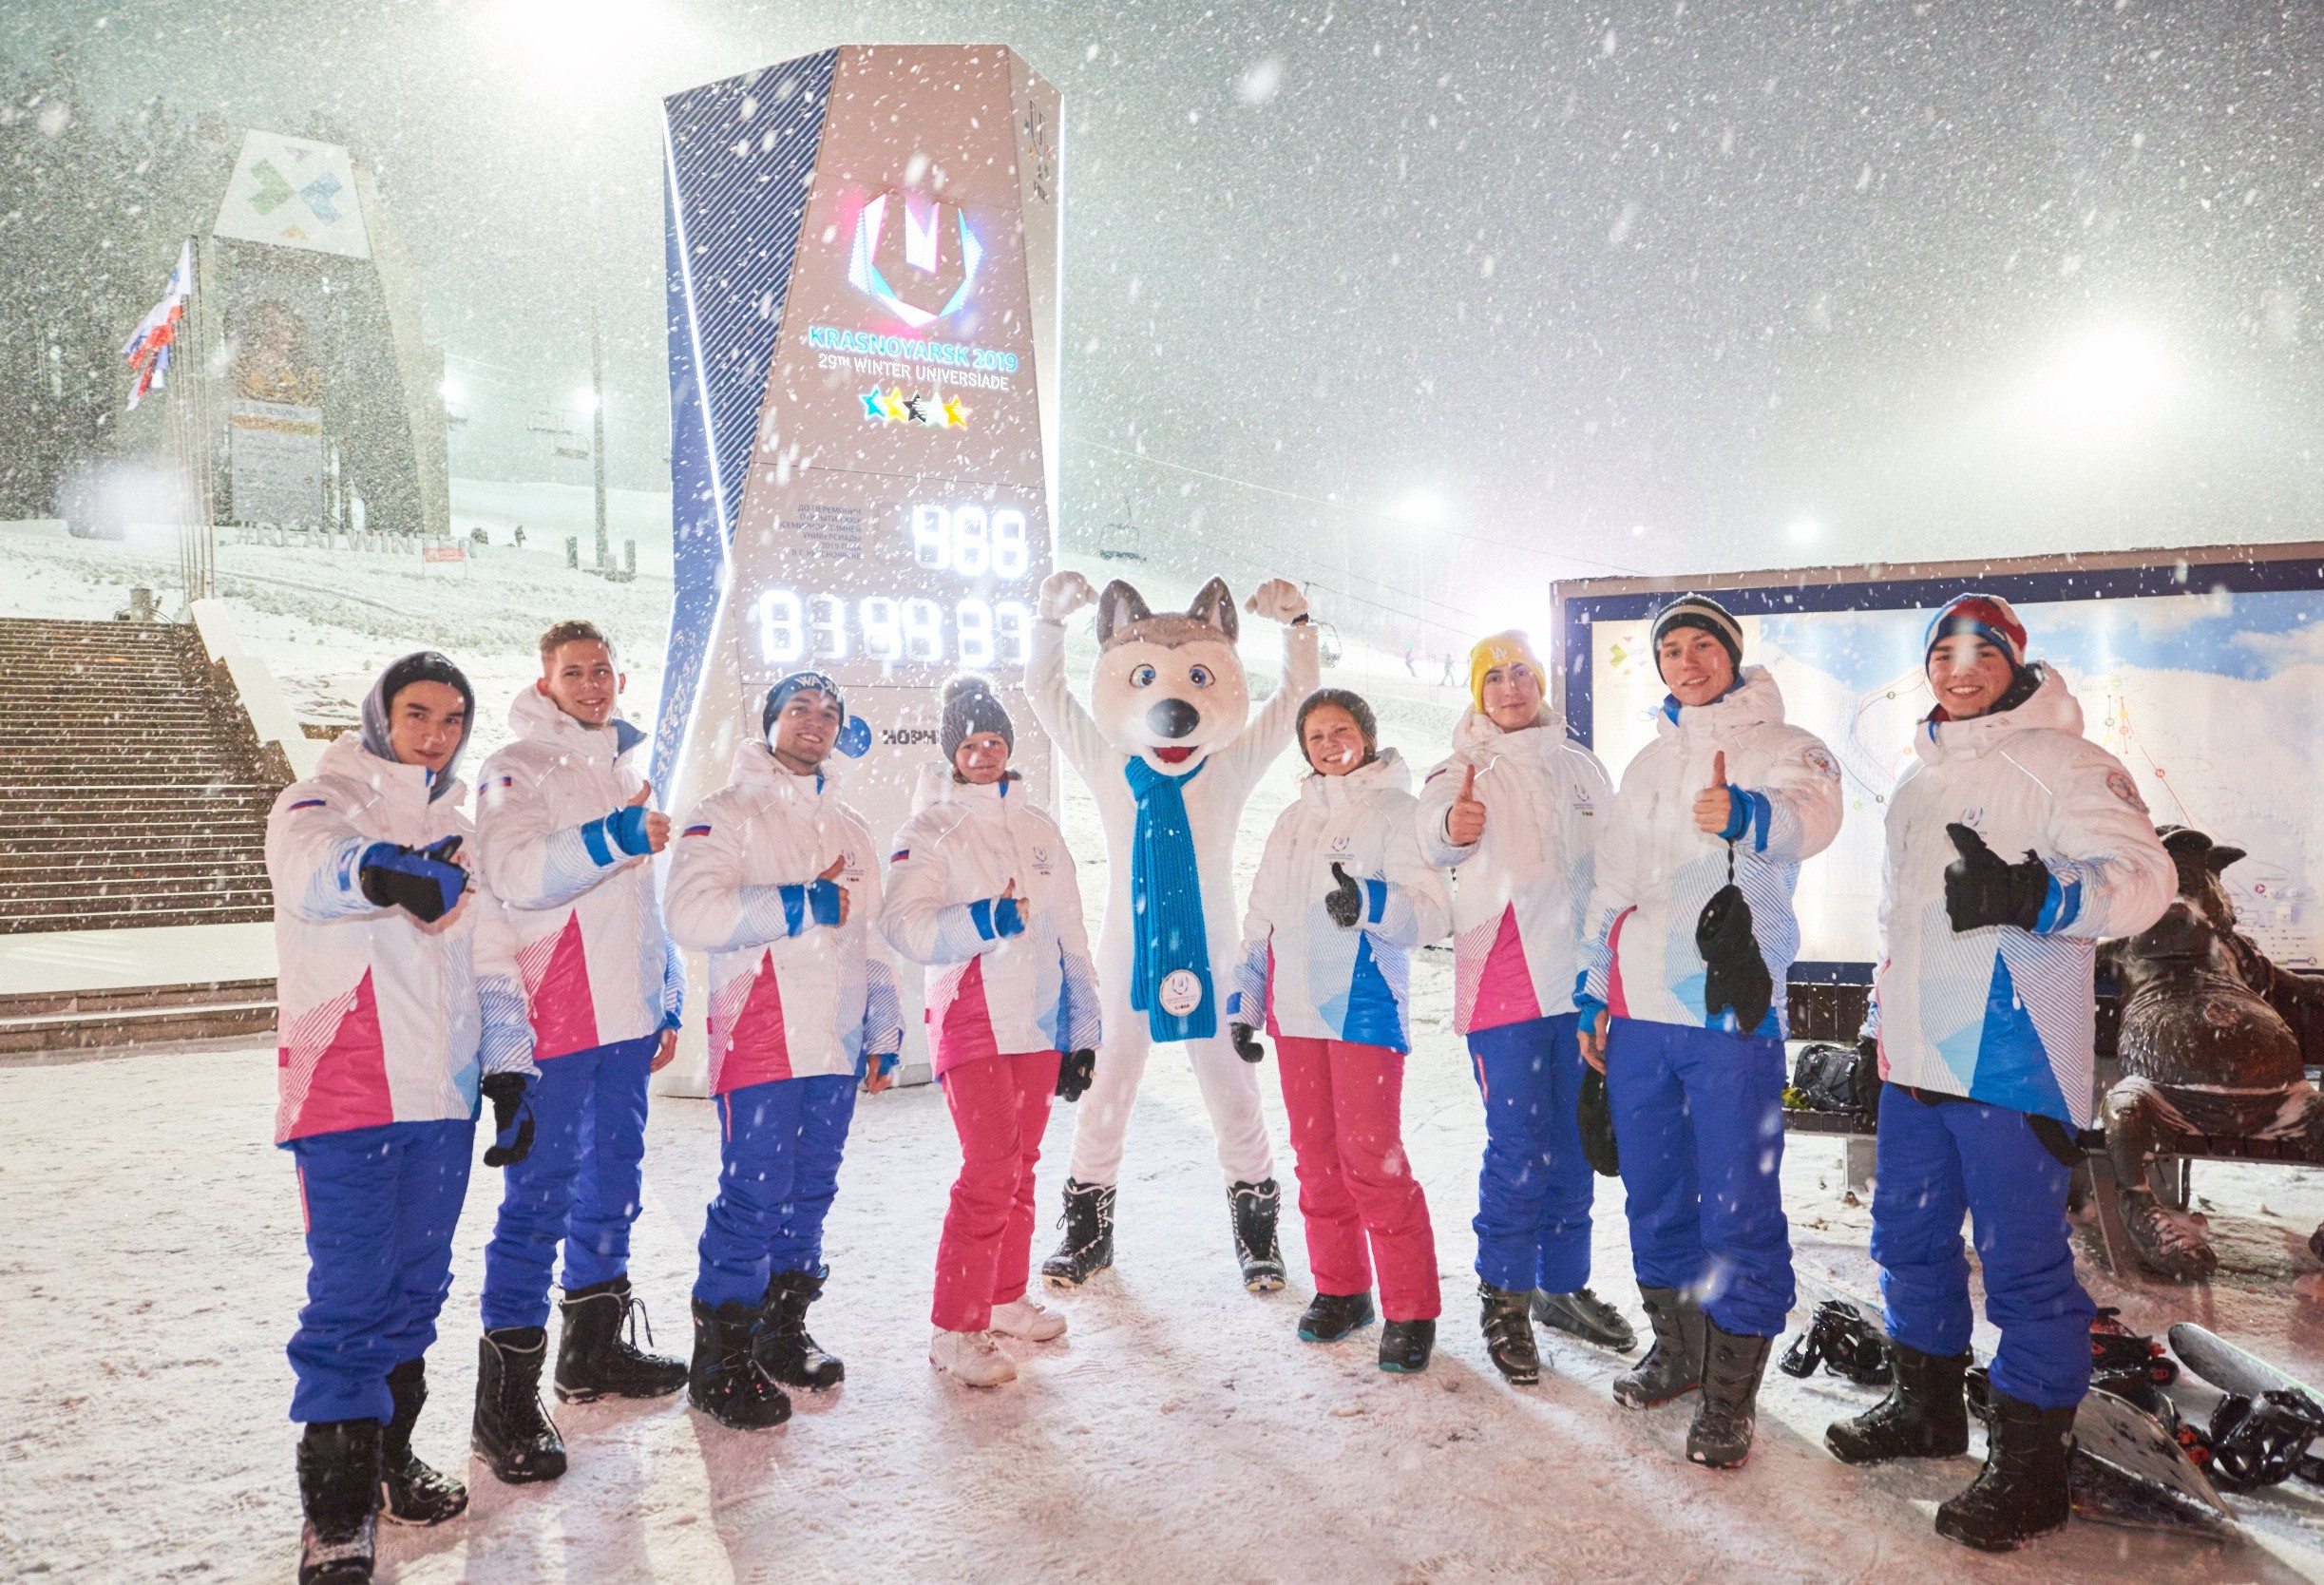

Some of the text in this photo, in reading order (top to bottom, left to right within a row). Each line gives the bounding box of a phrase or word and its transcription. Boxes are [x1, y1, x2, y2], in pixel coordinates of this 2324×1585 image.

[809, 325, 1019, 372] KRASNOYARSK 2019
[854, 357, 911, 378] WINTER
[915, 365, 1010, 391] UNIVERSIADE
